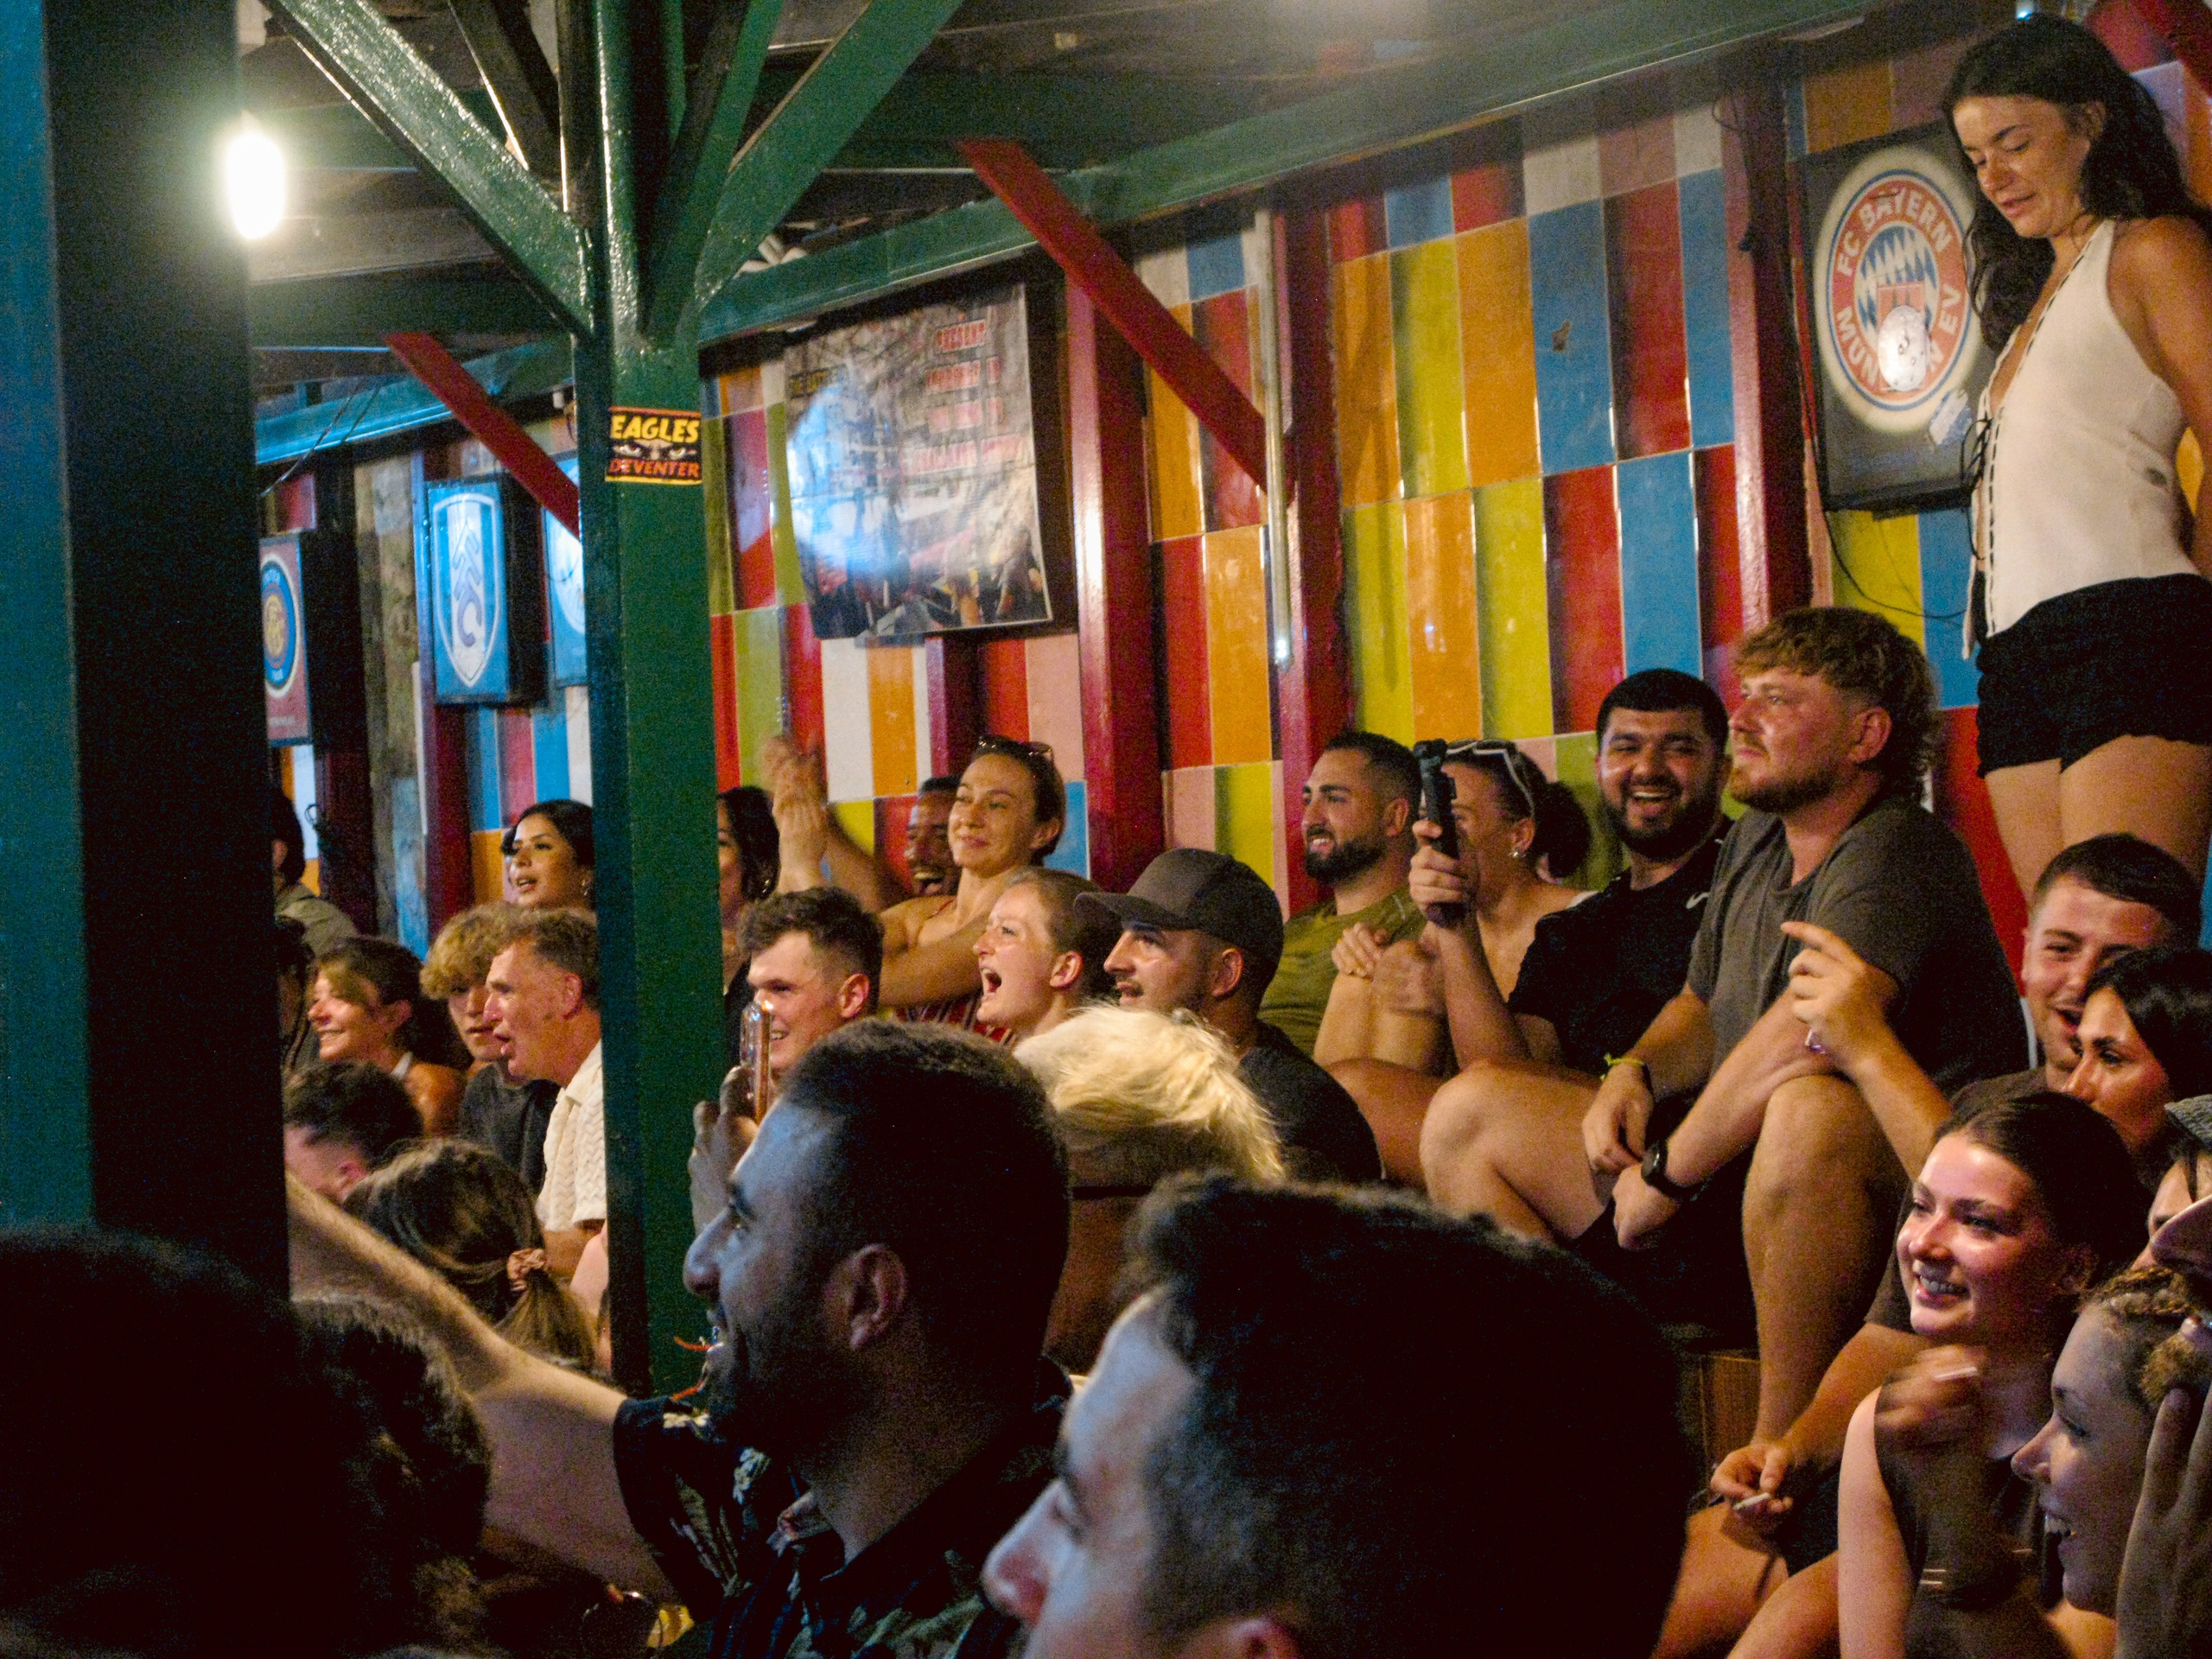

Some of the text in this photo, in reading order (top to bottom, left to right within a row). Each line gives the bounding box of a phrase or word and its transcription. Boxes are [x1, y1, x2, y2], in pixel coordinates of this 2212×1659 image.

[1837, 187, 1954, 276] FC BAYERN
[610, 414, 700, 443] EAGLES
[608, 457, 700, 478] DEVENTER
